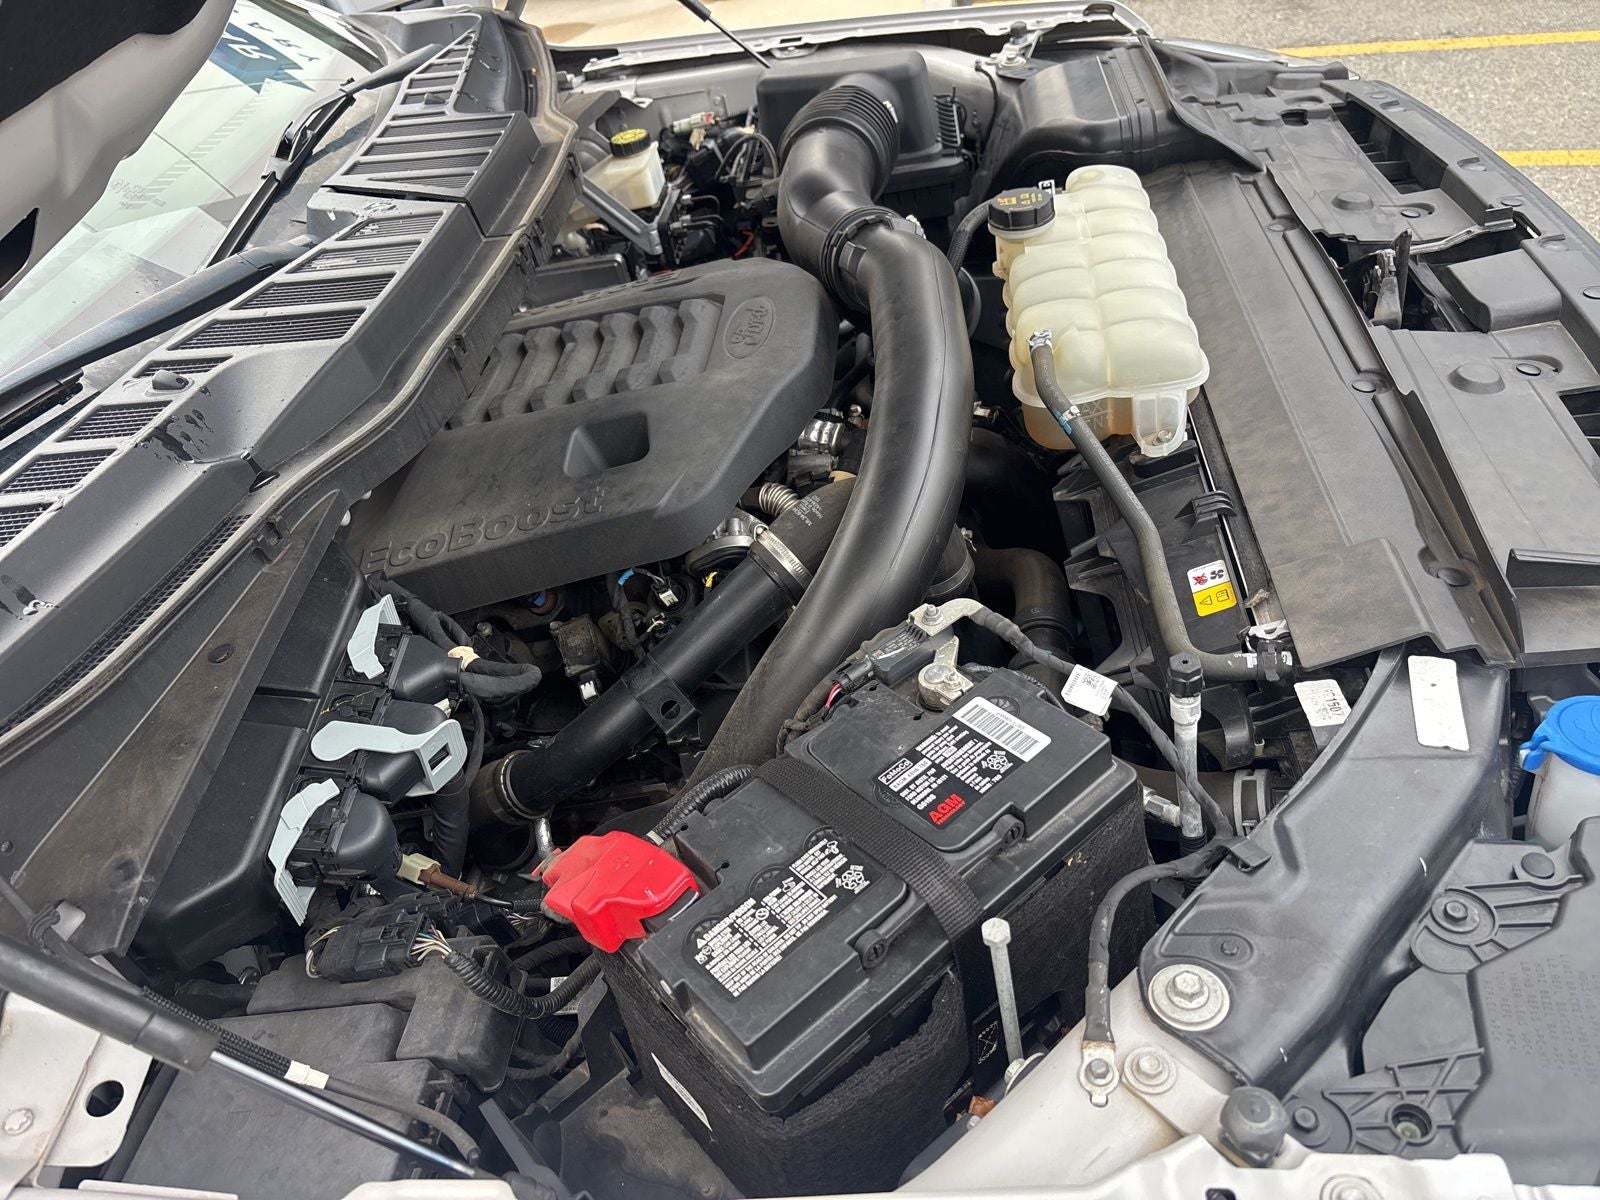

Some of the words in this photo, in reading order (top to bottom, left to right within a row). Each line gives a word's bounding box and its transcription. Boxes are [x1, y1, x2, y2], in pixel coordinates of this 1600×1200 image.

[359, 485, 606, 575] EcoBoost
[881, 760, 911, 783] FoMoCo
[929, 794, 963, 821] AGM
[704, 898, 756, 941] DANGER/POISON
